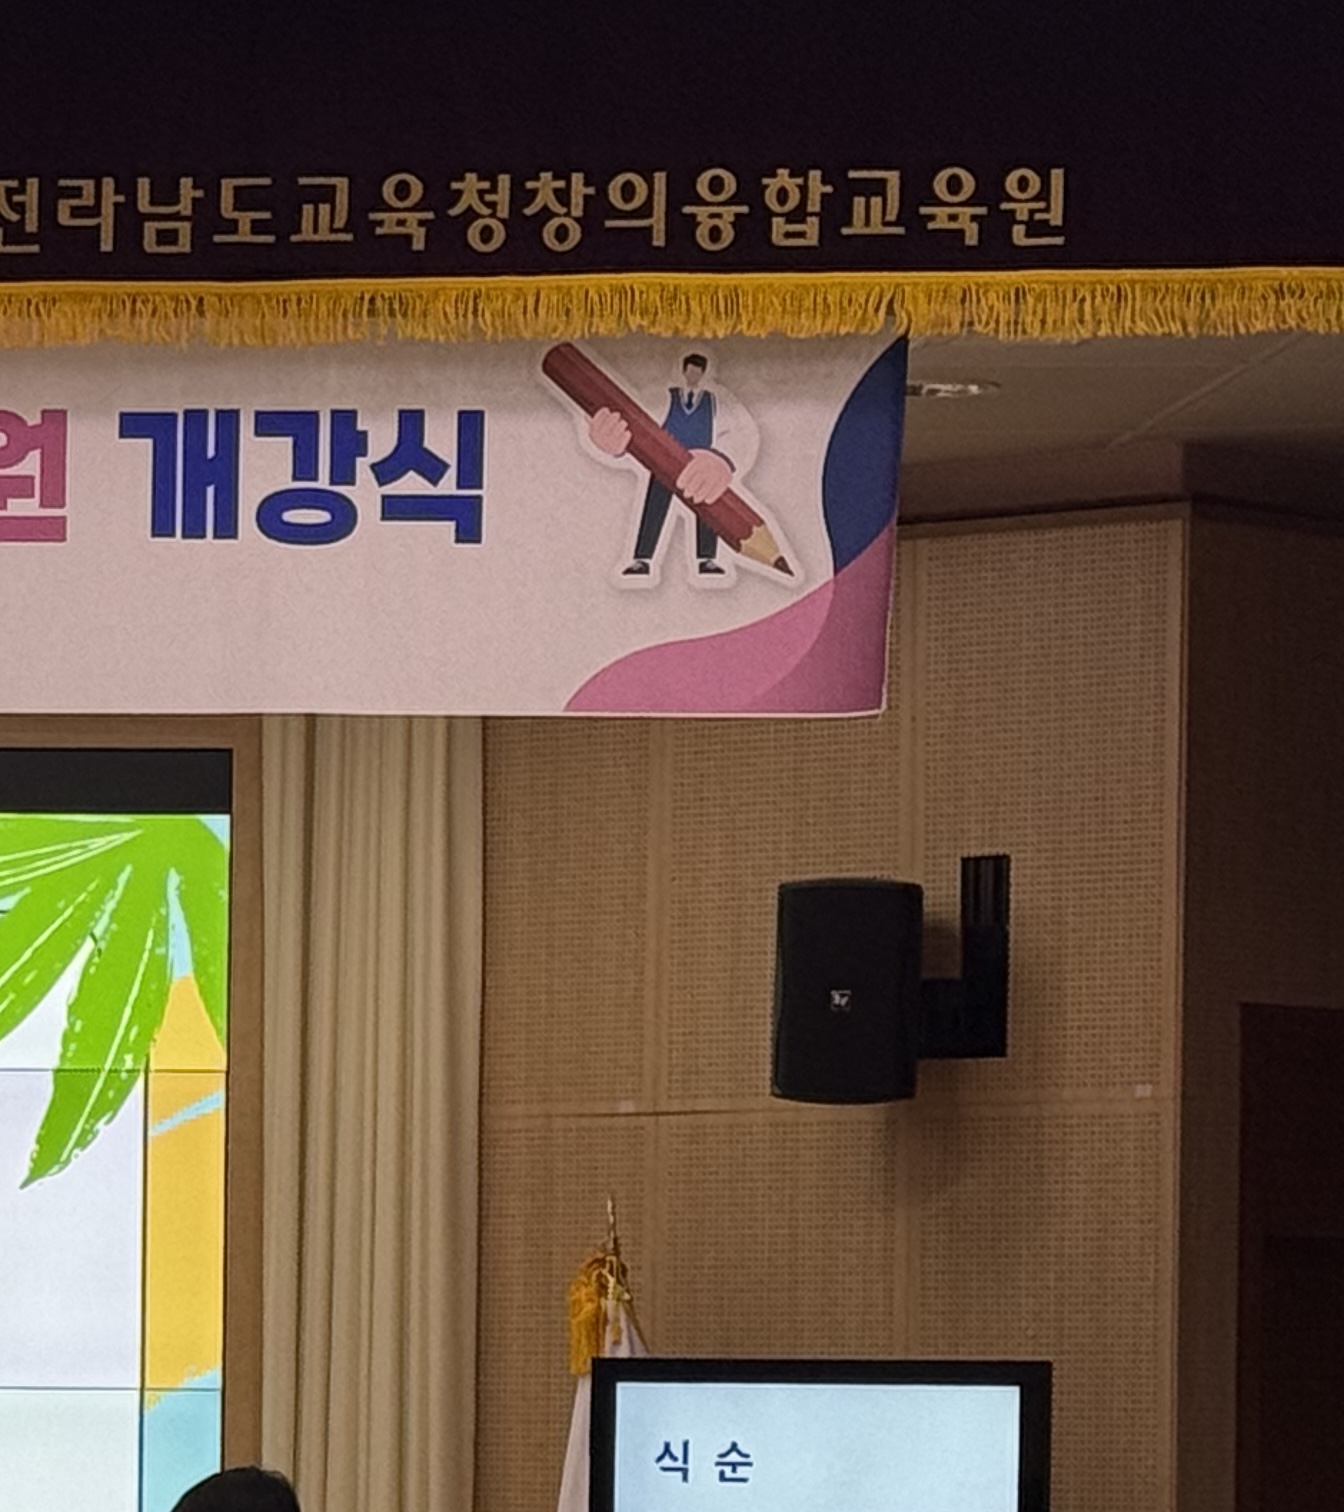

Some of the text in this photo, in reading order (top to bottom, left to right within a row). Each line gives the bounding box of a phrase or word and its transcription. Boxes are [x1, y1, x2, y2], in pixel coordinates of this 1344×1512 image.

[116, 407, 487, 546] 개강식
[654, 1438, 755, 1484] 식 순
